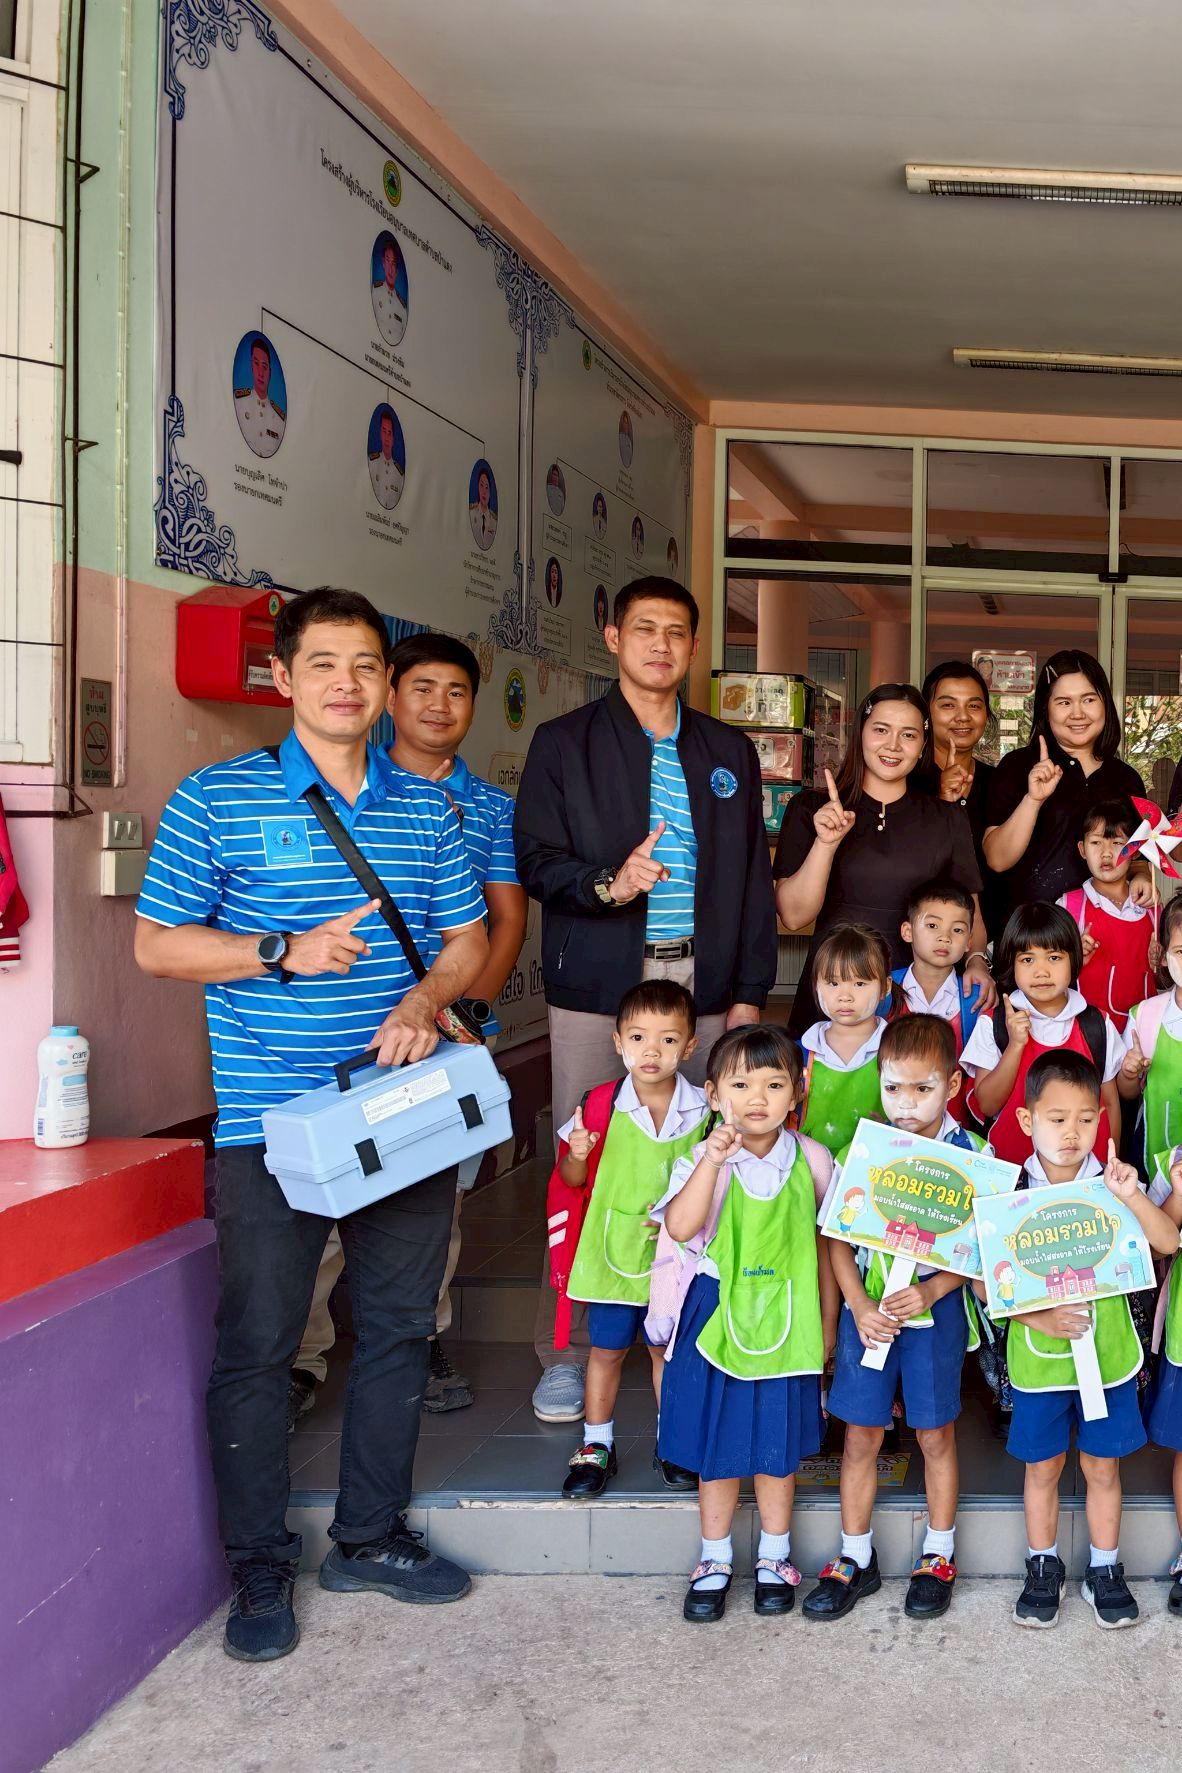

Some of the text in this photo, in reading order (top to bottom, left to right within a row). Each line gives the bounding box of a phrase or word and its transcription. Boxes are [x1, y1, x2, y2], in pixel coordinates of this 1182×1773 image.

[498, 764, 521, 785] เอกลัก
[915, 1160, 951, 1180] โครงการ
[868, 1165, 975, 1211] หลอมรวมใ
[873, 1193, 963, 1226] มอบน้ำใสสะอาด ให้โรงเรียน
[1040, 1208, 1077, 1221] โครงการ
[1003, 1209, 1121, 1252] หลอมรวมใจ
[1019, 1242, 1112, 1267] มอบน้ำใสสะอาด ให้โรงเรียน
